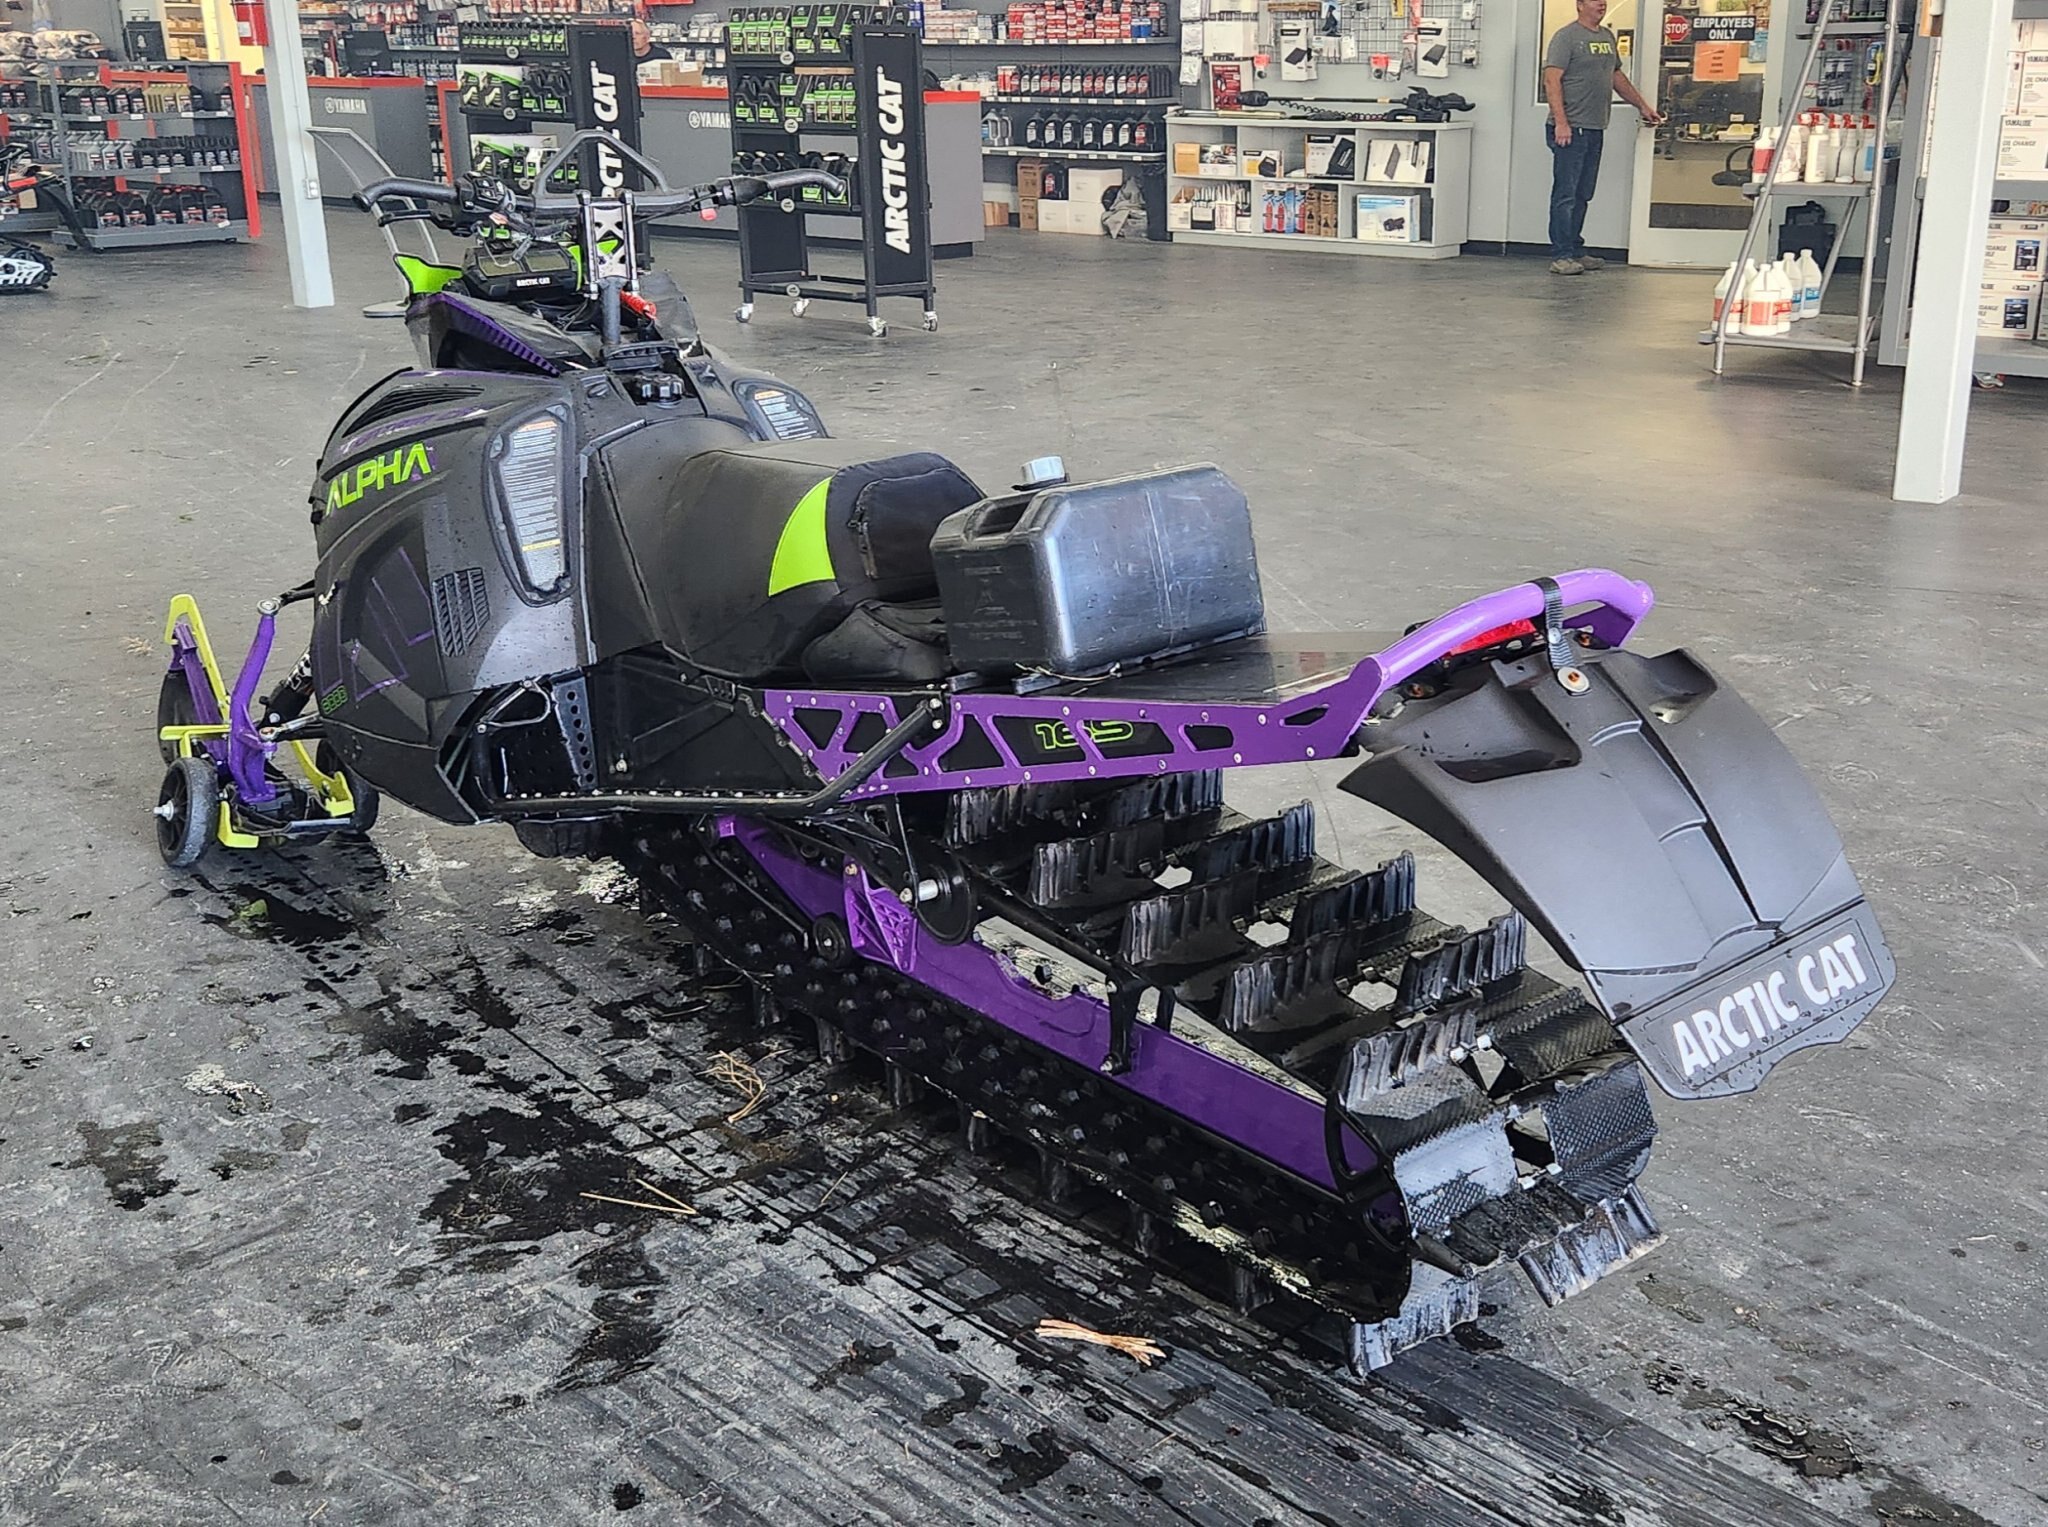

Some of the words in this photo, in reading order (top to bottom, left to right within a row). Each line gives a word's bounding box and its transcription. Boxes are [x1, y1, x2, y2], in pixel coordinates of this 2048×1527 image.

[1665, 23, 1689, 34] STOP
[1693, 17, 1755, 29] EMPLOYEES
[1708, 28, 1737, 40] ONLY
[591, 62, 619, 122] CAT
[699, 111, 731, 129] YAMAH
[877, 66, 904, 135] CAT
[880, 138, 911, 254] ARCTIC
[325, 441, 432, 516] ALPHA
[1672, 970, 1800, 1077] ARCTIC
[1798, 934, 1868, 1006] CAT
